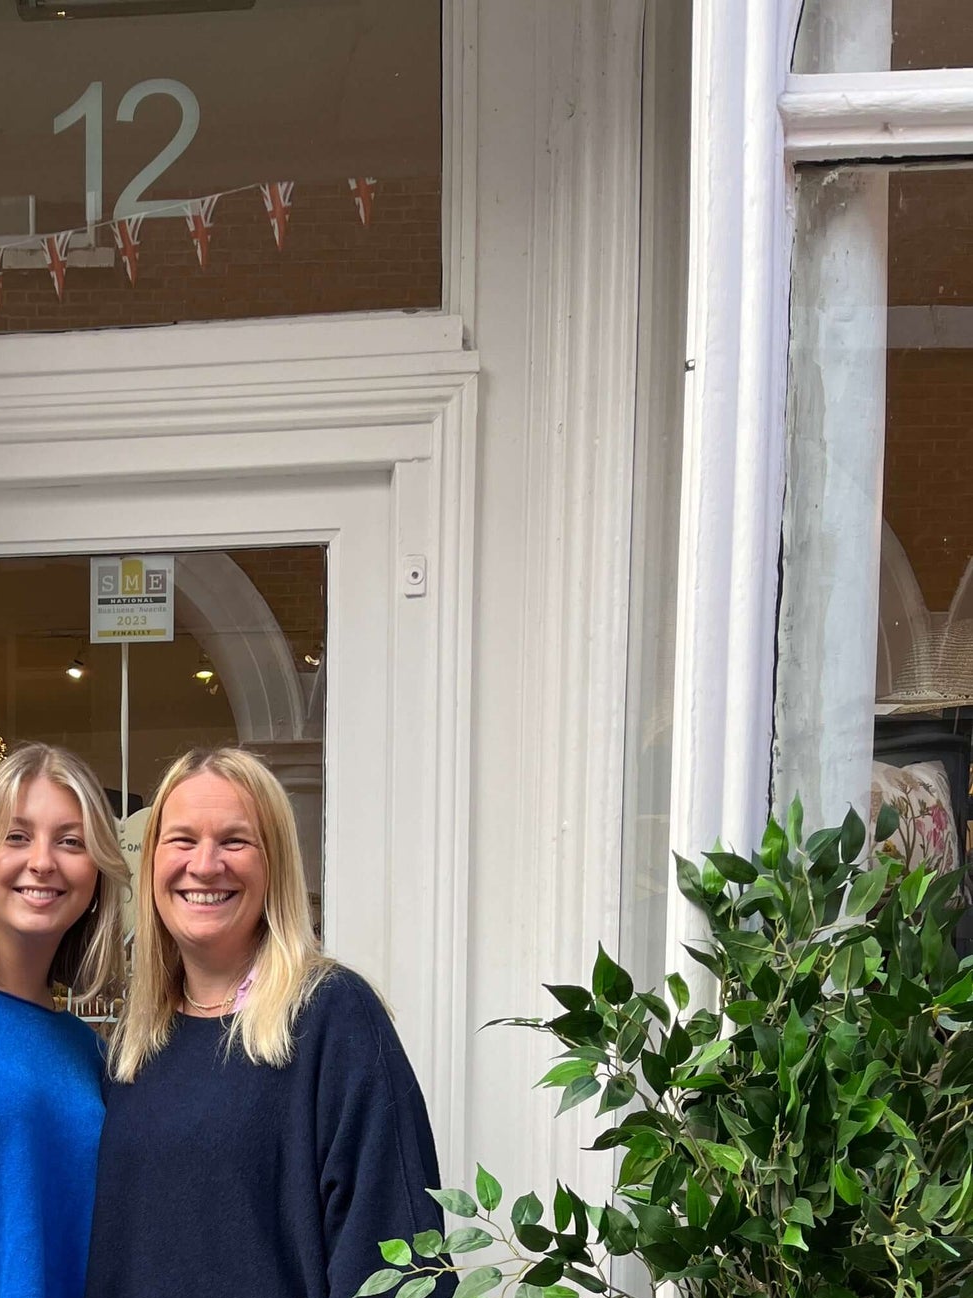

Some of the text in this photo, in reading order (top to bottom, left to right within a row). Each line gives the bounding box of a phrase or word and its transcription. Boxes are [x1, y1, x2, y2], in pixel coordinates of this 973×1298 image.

[53, 78, 201, 220] 12
[101, 573, 163, 592] SME
[98, 605, 167, 614] Business Awards
[117, 616, 147, 626] 2023
